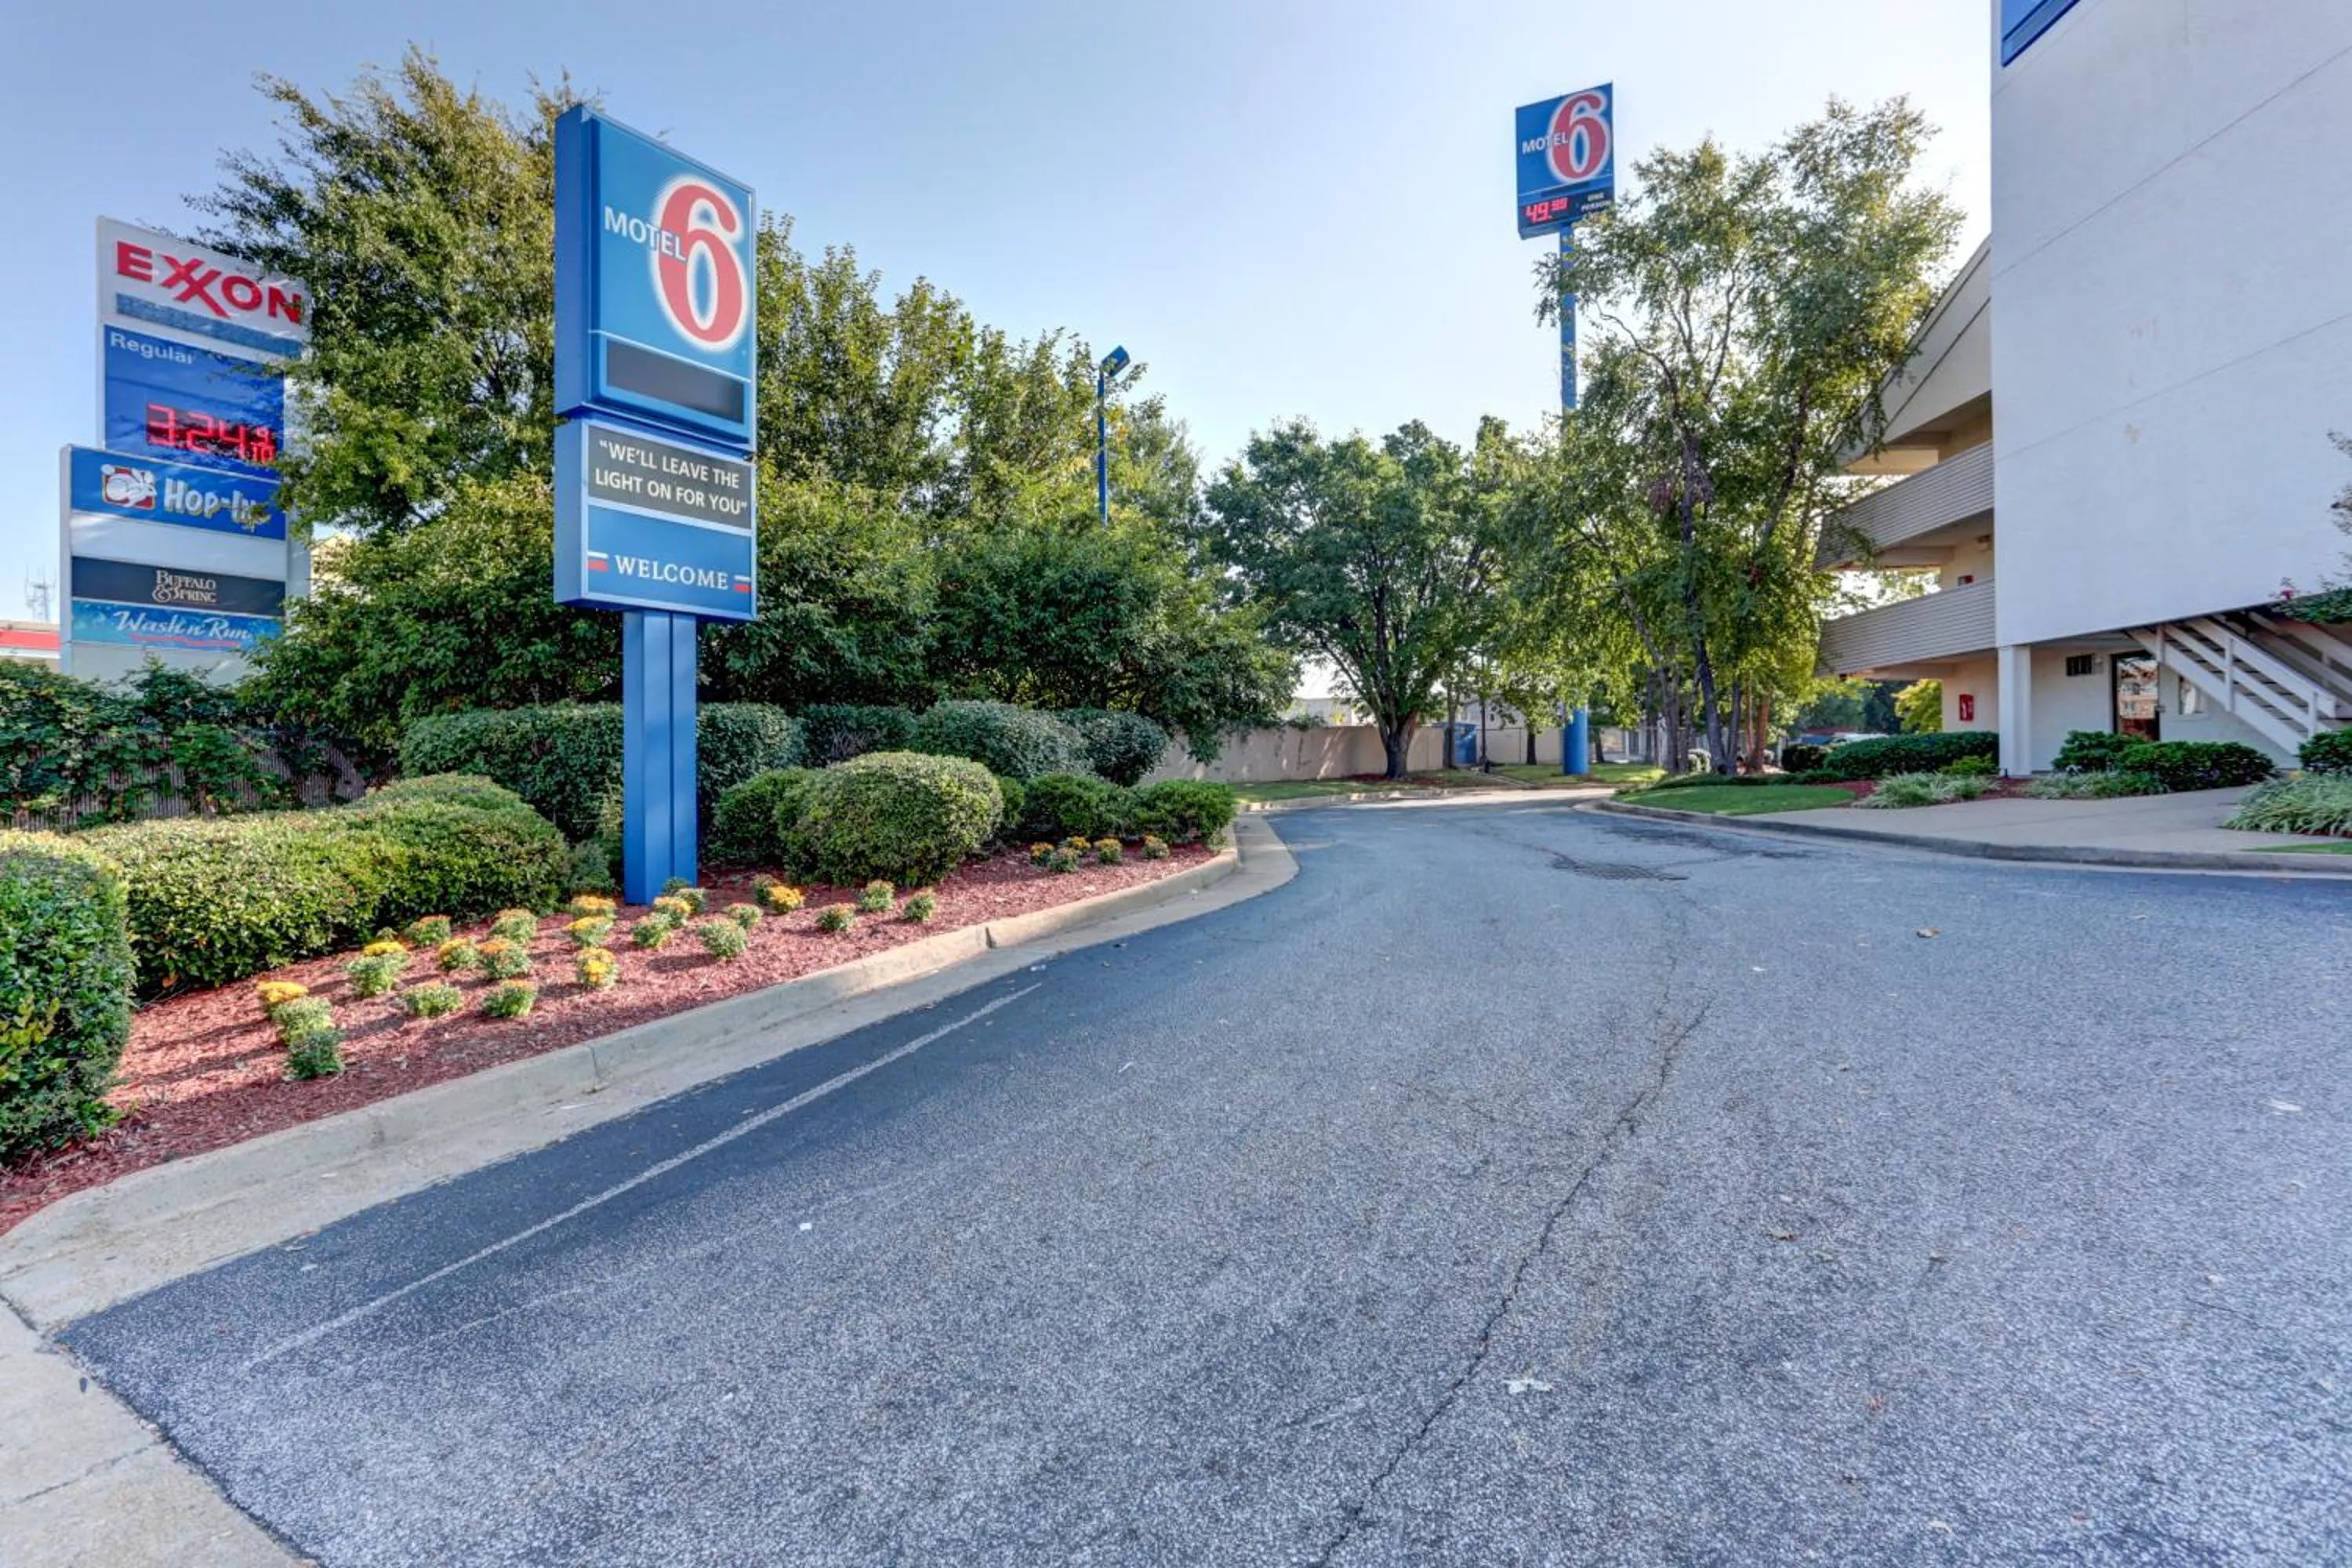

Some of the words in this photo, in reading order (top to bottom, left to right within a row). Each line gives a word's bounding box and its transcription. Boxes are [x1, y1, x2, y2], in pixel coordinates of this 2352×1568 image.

[1523, 132, 1568, 154] MOTEL
[1548, 91, 1608, 182] 6
[604, 205, 688, 263] MOTEL
[653, 178, 748, 349] 6
[117, 240, 302, 325] EXXON
[110, 332, 193, 365] Regular
[595, 469, 643, 494] LIGHT
[648, 482, 671, 501] ON
[676, 486, 705, 507] FOR
[662, 457, 709, 481] LEAVE
[713, 468, 739, 489] THE
[156, 569, 217, 590] BUFFALO
[615, 554, 728, 590] WELCOME
[113, 610, 184, 634] Wash
